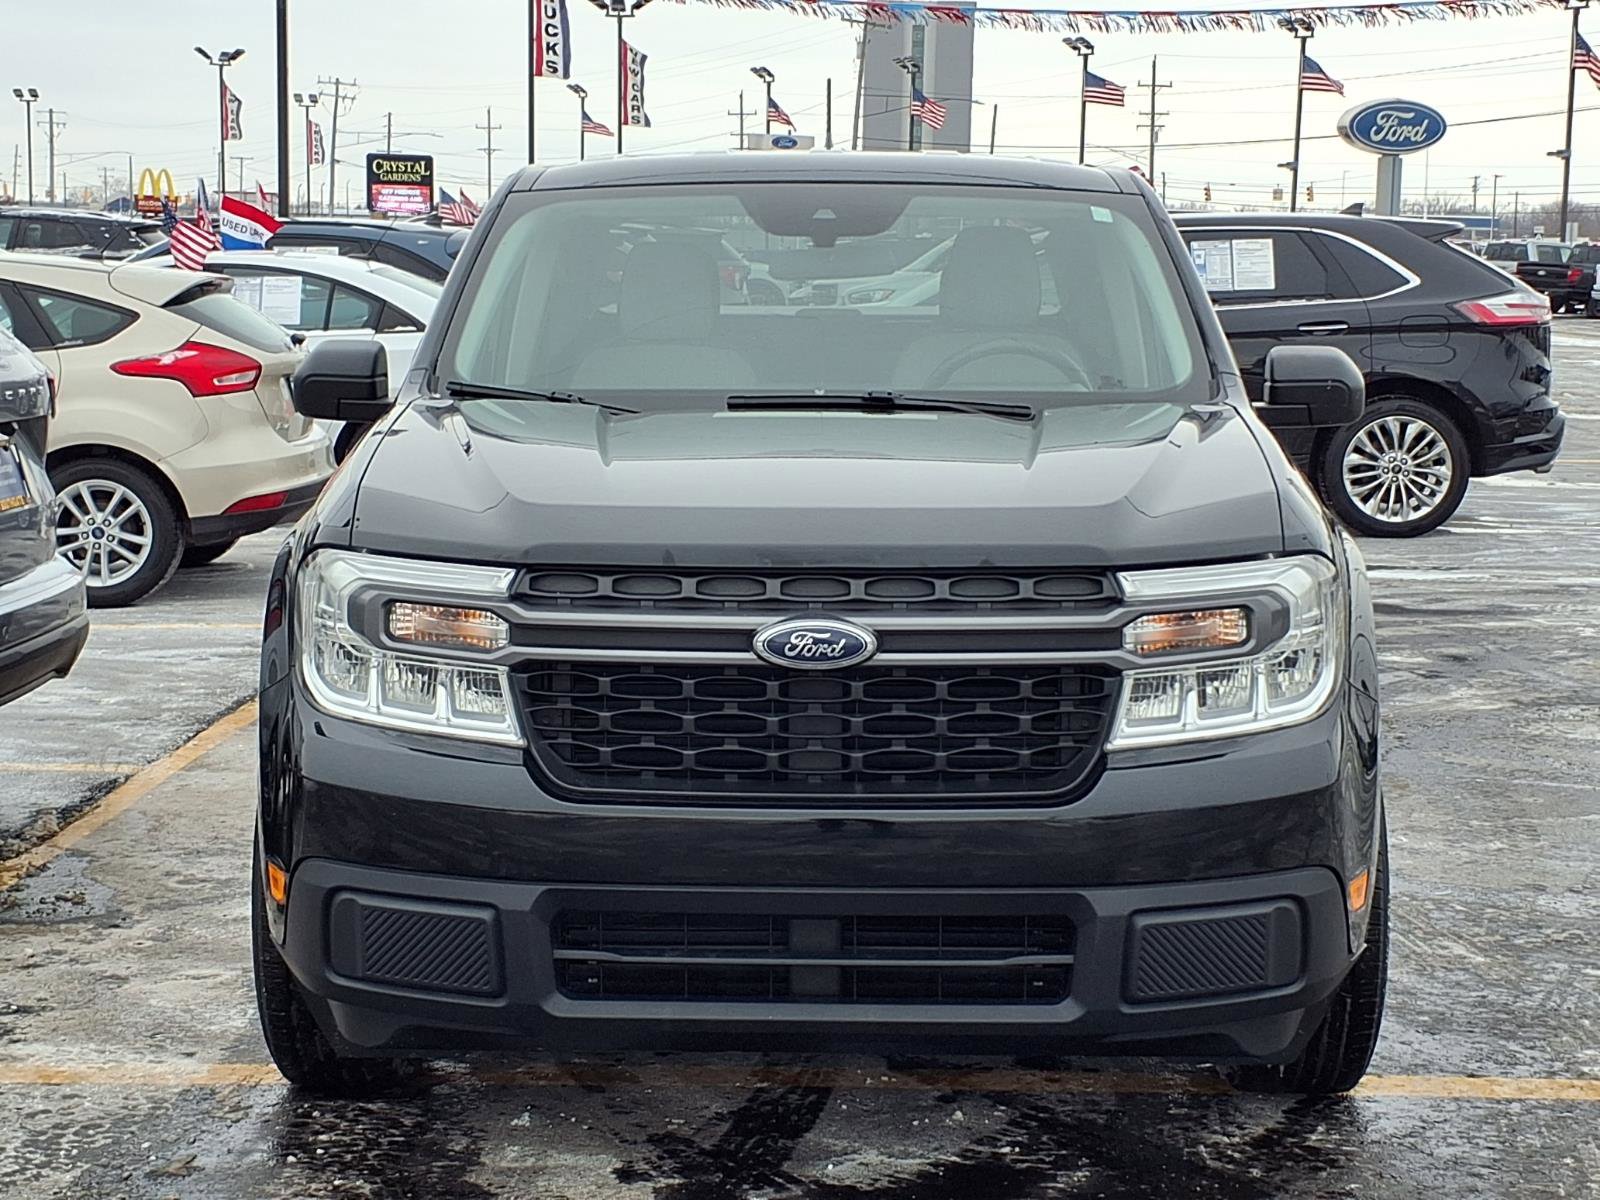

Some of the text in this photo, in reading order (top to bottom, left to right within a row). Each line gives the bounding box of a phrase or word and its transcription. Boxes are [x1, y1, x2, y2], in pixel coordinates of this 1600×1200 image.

[544, 0, 559, 74] UCKS
[630, 83, 641, 125] CARS
[1370, 110, 1429, 142] Ford
[372, 159, 431, 176] CRYSTAL
[380, 173, 421, 182] GARDENS
[222, 217, 248, 234] USED
[784, 631, 846, 657] Ford
